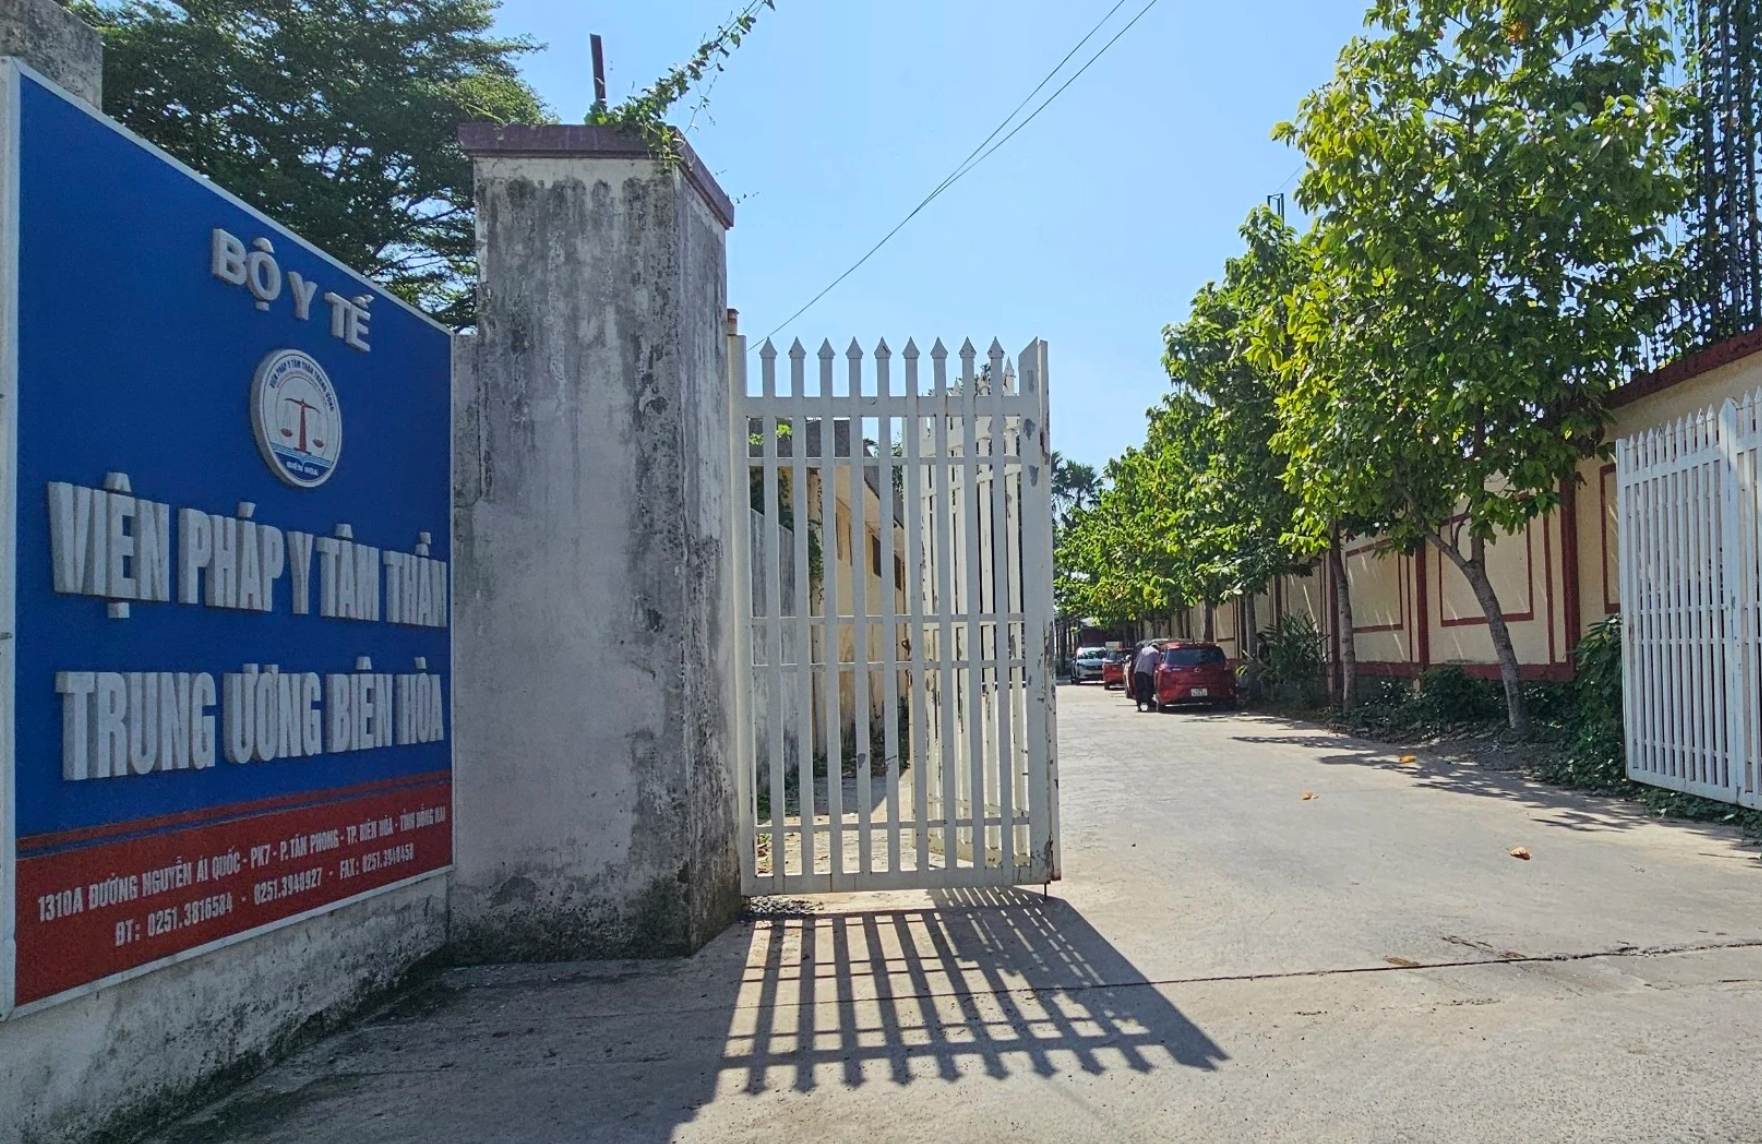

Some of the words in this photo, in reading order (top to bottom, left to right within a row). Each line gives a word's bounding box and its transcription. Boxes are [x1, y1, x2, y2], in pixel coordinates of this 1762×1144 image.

[212, 228, 281, 311] BỘ
[288, 271, 317, 320] Y
[325, 292, 374, 351] TẾ
[48, 472, 169, 619] VIỆN
[178, 501, 284, 612] PHÁP
[287, 531, 313, 614] Y
[316, 524, 379, 621] TÂM
[383, 532, 447, 627] THẦN
[55, 671, 216, 781] TRUNG
[223, 663, 322, 764] ƯƠNG
[326, 656, 392, 753] BIÊN
[396, 657, 444, 745] HÒA
[38, 887, 84, 922] 1310A
[88, 872, 138, 910] ĐƯỜNG
[142, 856, 192, 897] NGUYỄN
[197, 855, 208, 882] ÁI
[212, 846, 240, 880] QUỐC
[250, 844, 270, 869] PK7
[310, 829, 339, 854] PHONG
